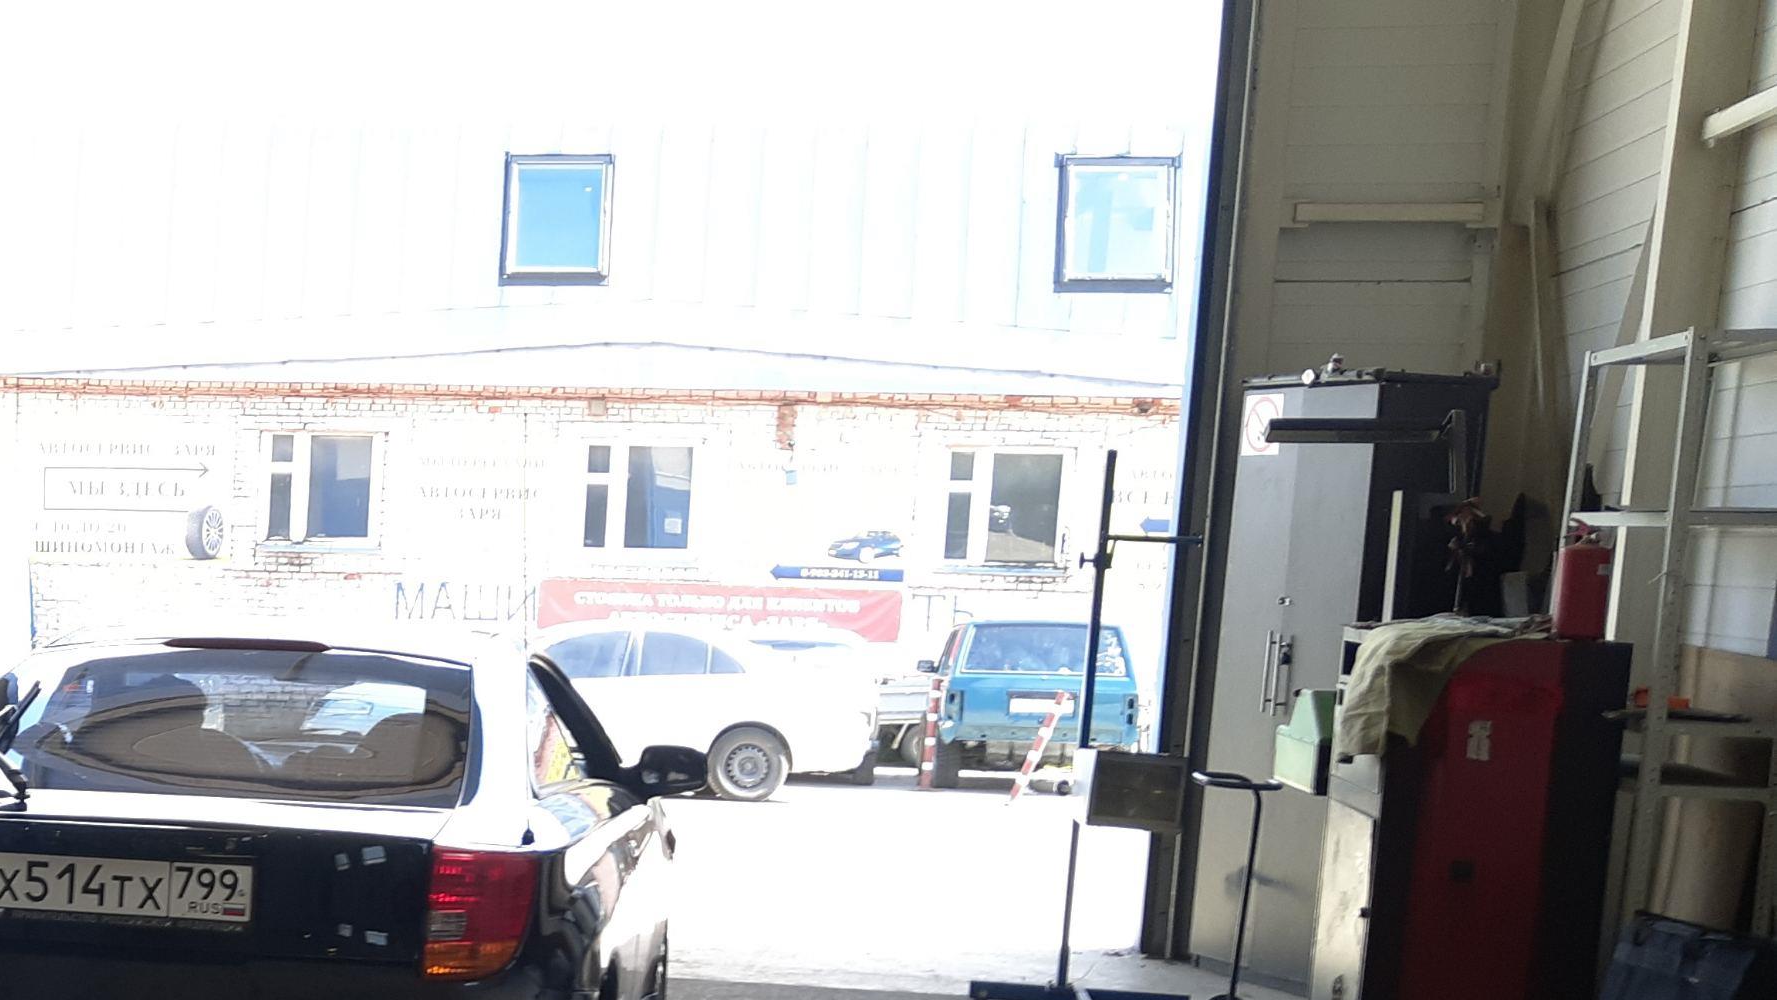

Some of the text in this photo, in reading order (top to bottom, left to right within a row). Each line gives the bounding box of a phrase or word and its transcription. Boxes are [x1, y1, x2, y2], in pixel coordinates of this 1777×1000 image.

[68, 480, 186, 498] МЫ ЗДЕСЬ
[35, 539, 175, 554] ШИНОМОНТАЖ
[175, 866, 239, 902] 799
[188, 901, 221, 914] RUS
